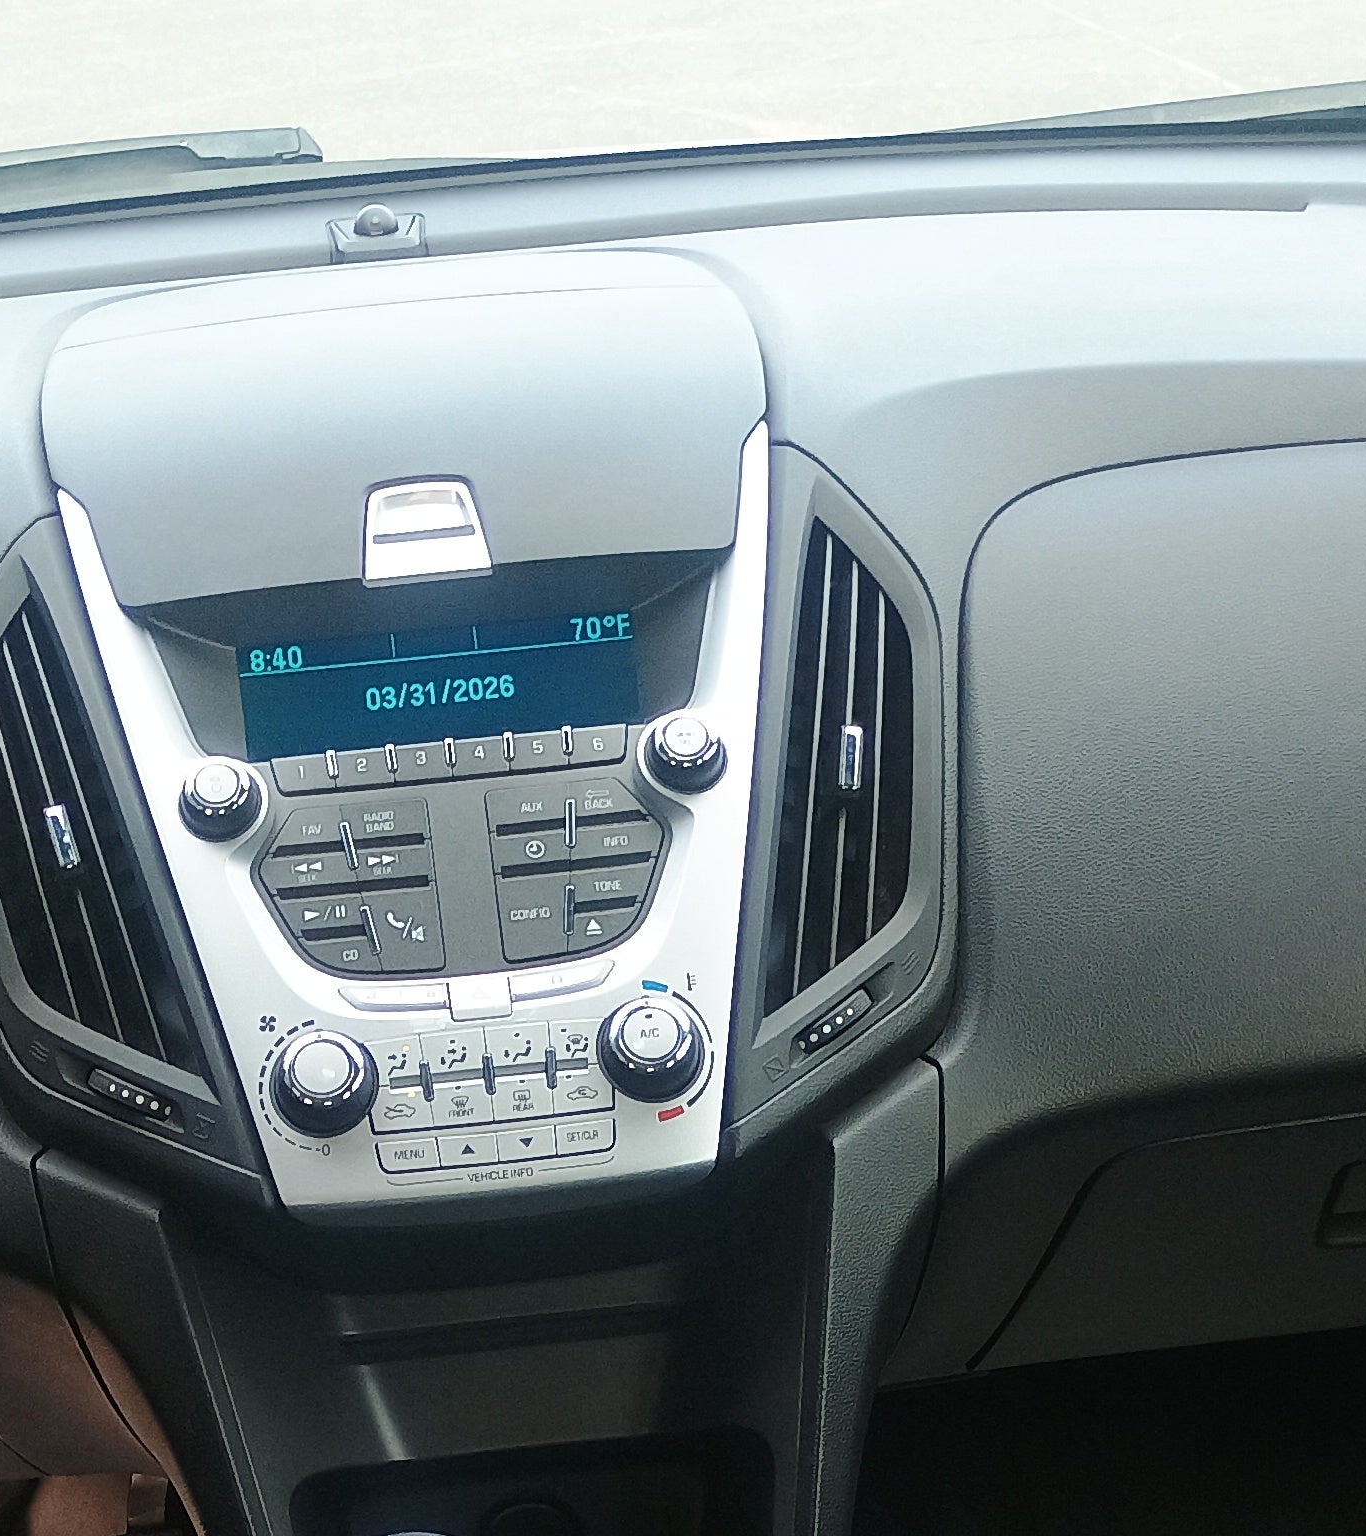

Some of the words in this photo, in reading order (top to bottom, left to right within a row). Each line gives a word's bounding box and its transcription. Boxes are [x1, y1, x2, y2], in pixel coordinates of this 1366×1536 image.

[569, 613, 630, 641] 70°F
[250, 646, 303, 672] 8:40
[366, 674, 515, 710] 03/31/2026
[299, 766, 305, 779] 1
[357, 758, 367, 772] 2
[416, 751, 427, 765] 3
[474, 746, 485, 760] 4
[533, 740, 543, 754] 5
[593, 737, 604, 751] 6
[520, 802, 543, 813] AUX
[301, 824, 323, 836] FAV
[603, 836, 629, 847] INFO
[593, 880, 622, 892] TONE
[342, 949, 359, 961] CD
[640, 1028, 660, 1038] A/C
[394, 1149, 425, 1160] MENU
[467, 1170, 510, 1183] VEHICLE
[510, 1167, 534, 1178] INFO
